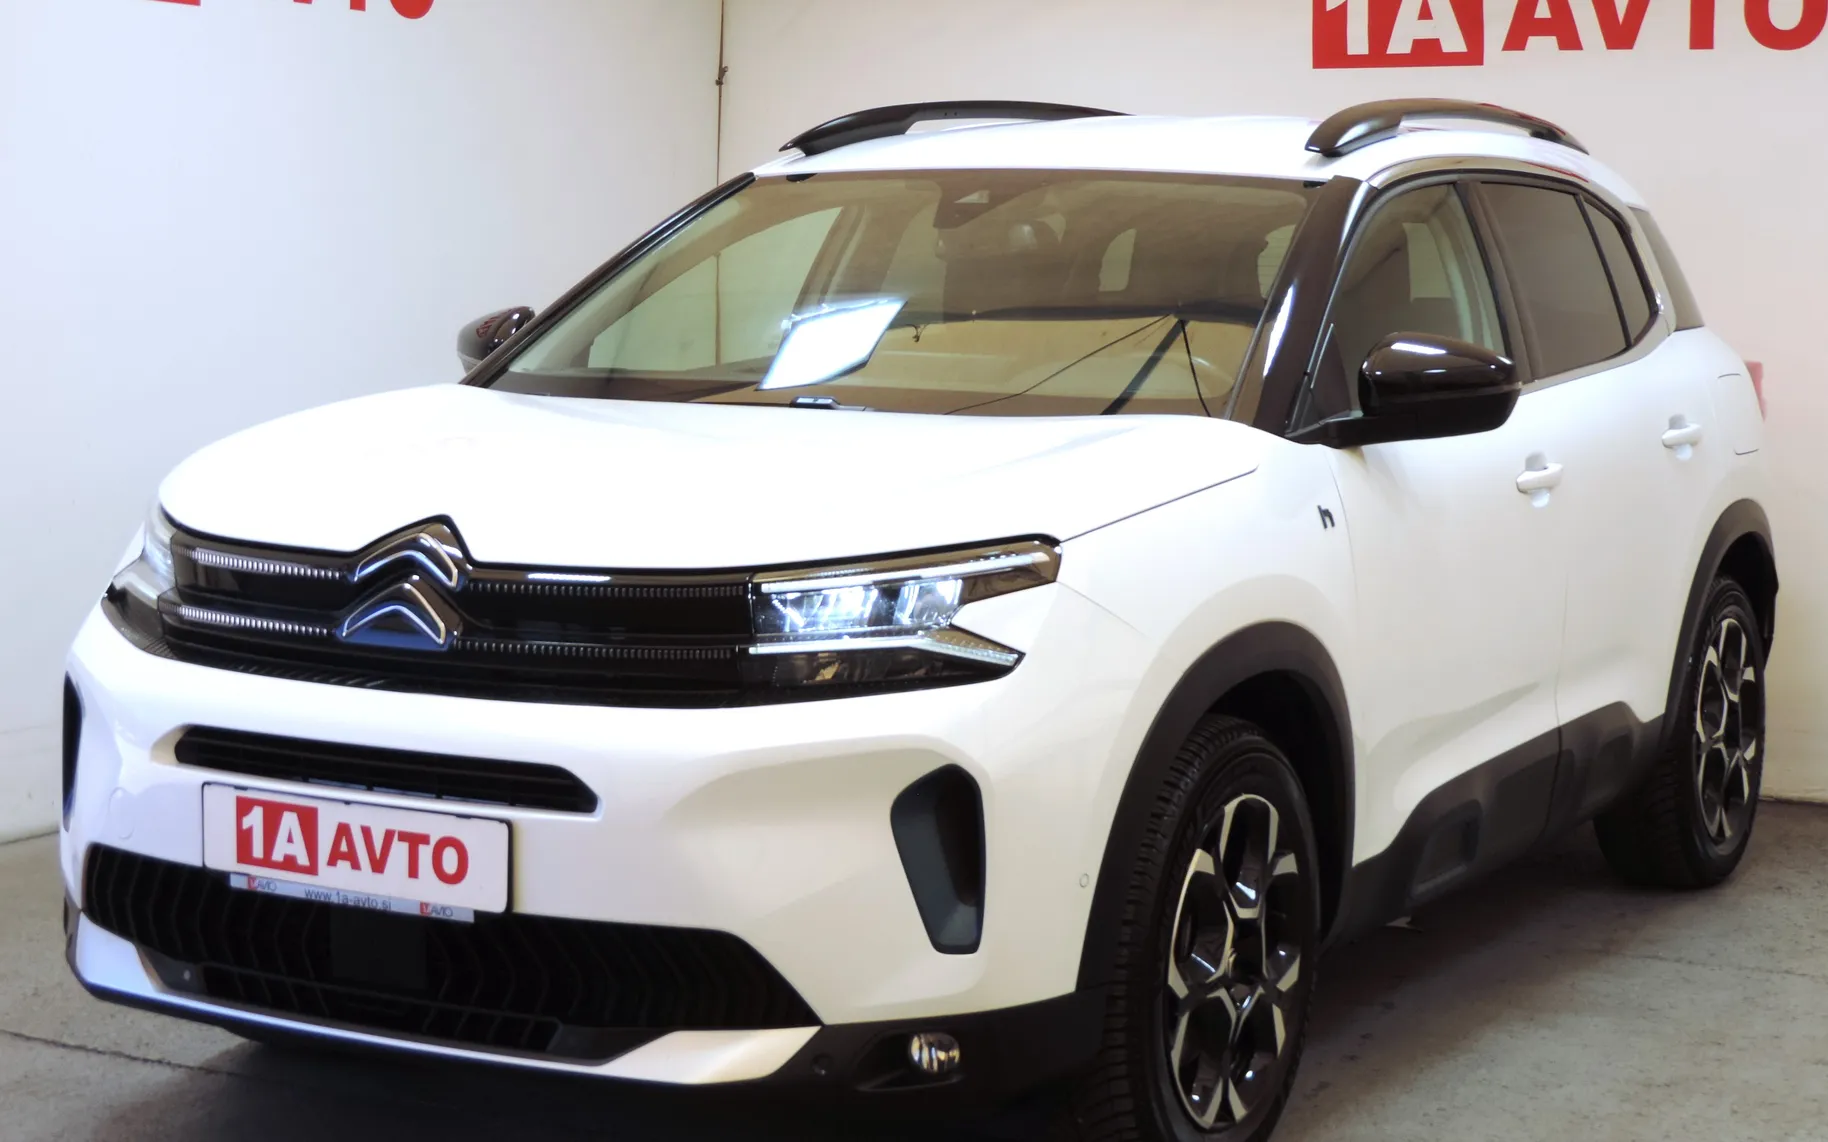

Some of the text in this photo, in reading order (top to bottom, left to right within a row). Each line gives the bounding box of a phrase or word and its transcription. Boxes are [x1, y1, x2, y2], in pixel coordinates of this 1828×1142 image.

[1325, 0, 1468, 56] 1A
[242, 805, 469, 885] 1A AVTO
